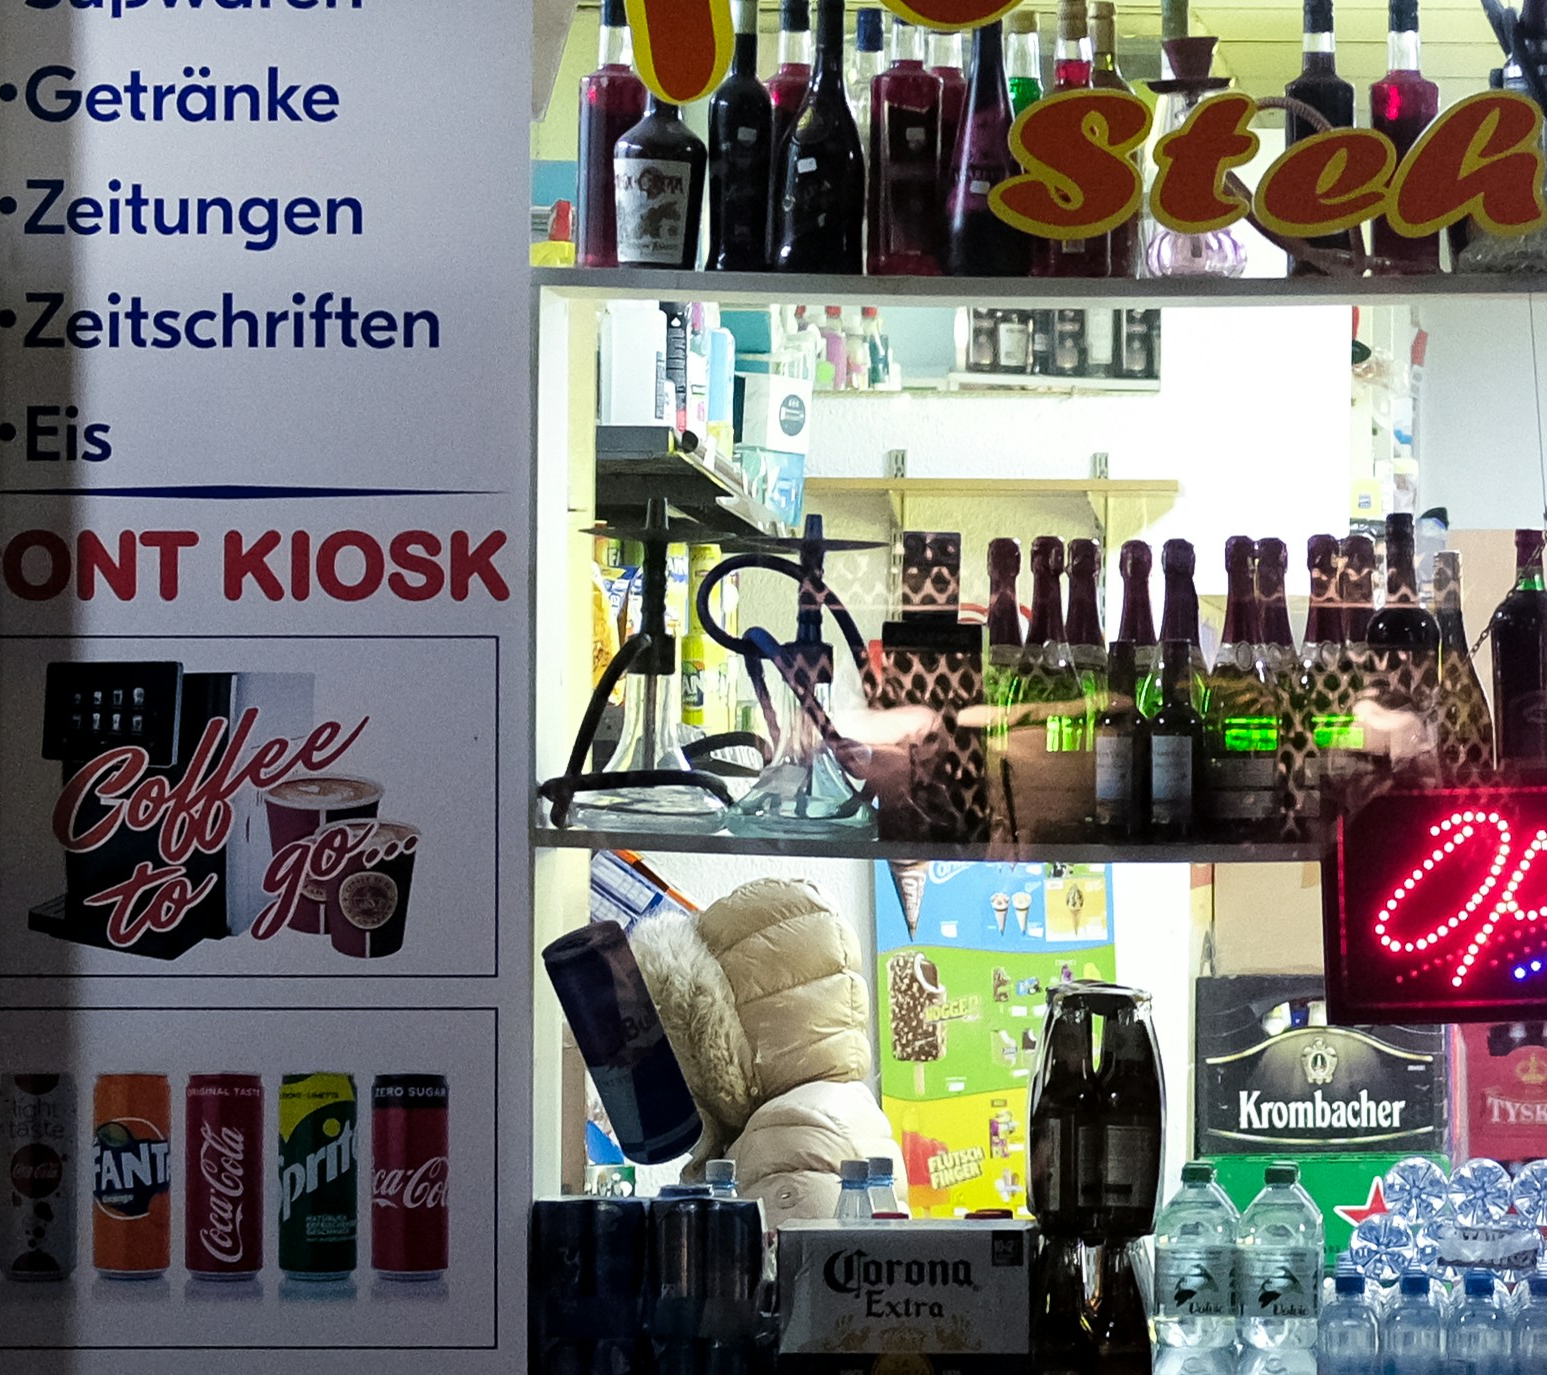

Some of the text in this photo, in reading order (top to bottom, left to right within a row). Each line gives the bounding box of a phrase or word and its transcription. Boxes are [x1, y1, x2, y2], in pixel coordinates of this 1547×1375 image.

[24, 64, 340, 123] Getränke
[987, 88, 1546, 238] Steh
[24, 178, 364, 251] Zeitungen
[23, 291, 441, 350] Zeitschriften
[24, 404, 113, 463] Eis
[224, 528, 511, 603] KIOSK
[52, 707, 370, 864] Coffee
[84, 861, 218, 947] to
[374, 1086, 447, 1099] ZERO SUGAR
[1238, 1089, 1406, 1130] Krombacher
[823, 1248, 975, 1299] Corona
[865, 1288, 945, 1319] Extra
